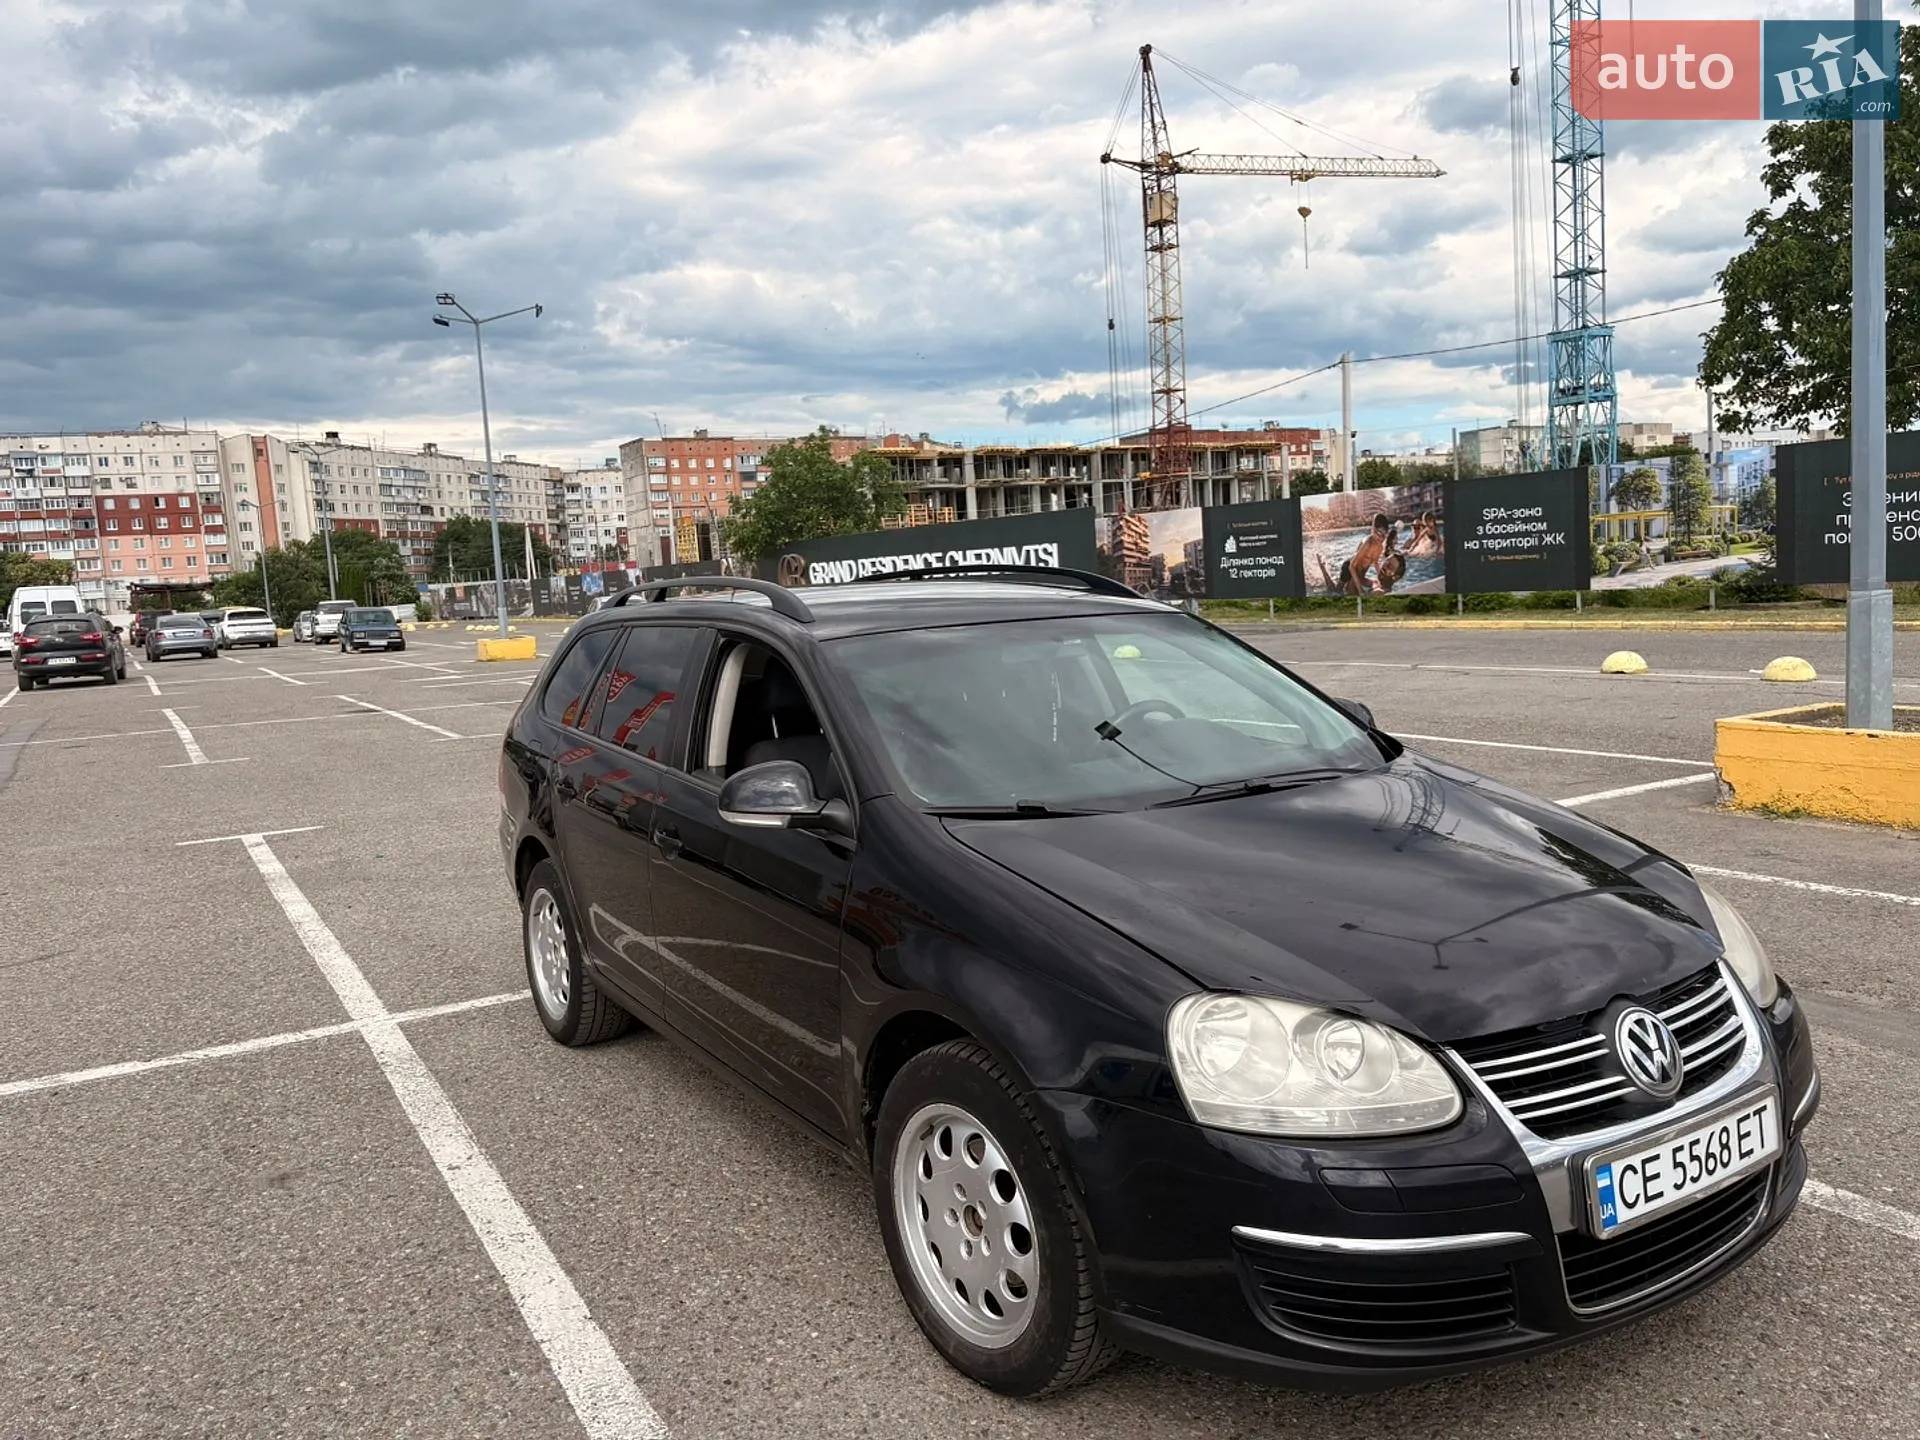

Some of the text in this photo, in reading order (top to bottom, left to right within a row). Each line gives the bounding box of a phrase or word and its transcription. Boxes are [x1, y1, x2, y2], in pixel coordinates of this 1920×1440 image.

[1482, 506, 1543, 521] SPA-зона
[1476, 521, 1547, 535] з басейном
[1464, 532, 1566, 551] на території ЖК
[809, 559, 857, 585] GRAND
[858, 552, 944, 581] RESIDENCE
[1220, 555, 1286, 569] Ділянка понад
[1229, 567, 1238, 578] 12
[1618, 1105, 1768, 1209] CE 5568 ET
[1600, 1206, 1616, 1219] UA
